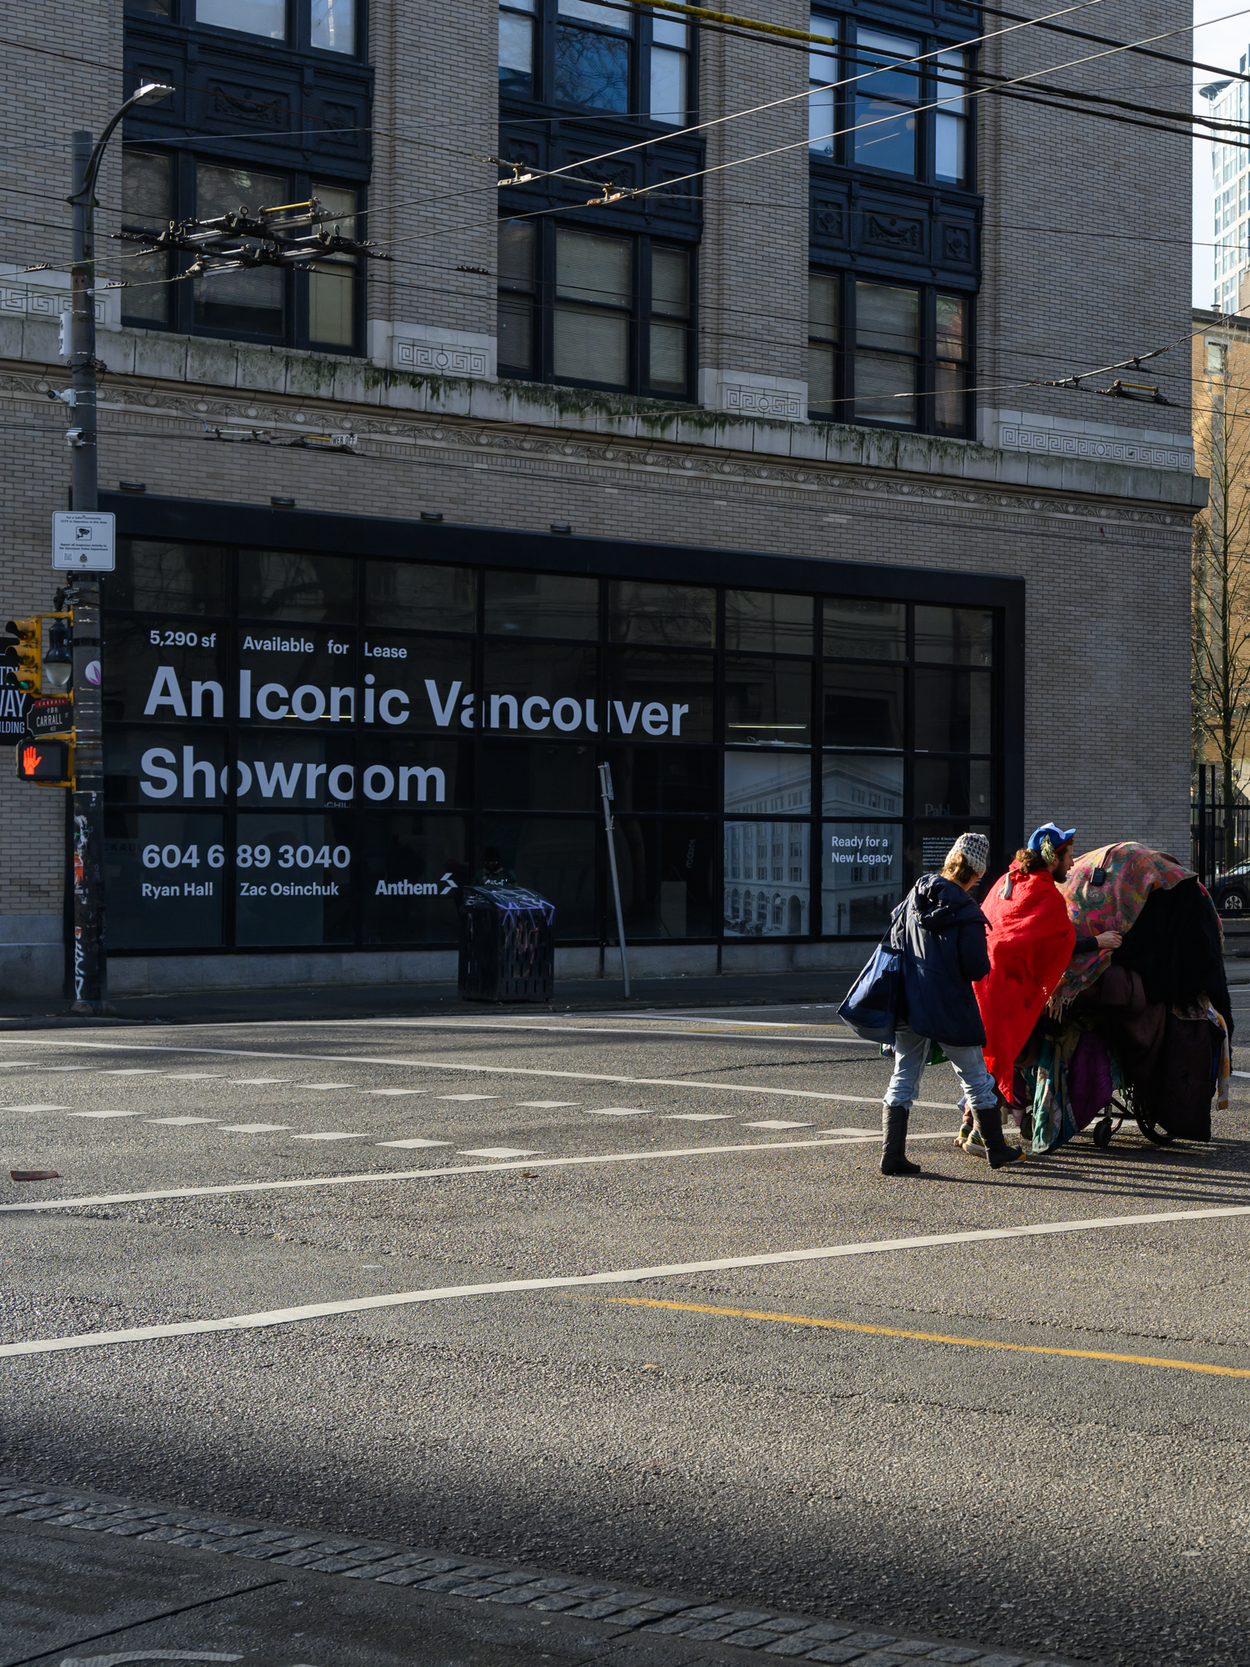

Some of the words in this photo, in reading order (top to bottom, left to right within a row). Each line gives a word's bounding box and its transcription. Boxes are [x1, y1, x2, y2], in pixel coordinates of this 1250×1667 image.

[150, 631, 197, 648] 5,290
[201, 632, 216, 647] sf
[243, 636, 314, 652] Available
[328, 639, 350, 654] for
[364, 643, 408, 658] Lease
[144, 666, 223, 718] An
[240, 669, 410, 725] Iconic
[424, 679, 688, 736] Vancouver
[36, 714, 63, 728] CARRALL
[140, 745, 445, 802] Showroom
[832, 836, 863, 849] Ready
[865, 836, 880, 847] for
[882, 839, 888, 847] a
[143, 844, 199, 868] 604
[278, 844, 351, 869] 3040
[831, 852, 855, 863] New
[857, 853, 893, 866] Legacy
[142, 883, 179, 899] Ryan
[184, 882, 213, 896] Hall
[240, 882, 267, 896] Zac
[270, 882, 339, 896] Osinchuk
[375, 879, 437, 896] Anthem
